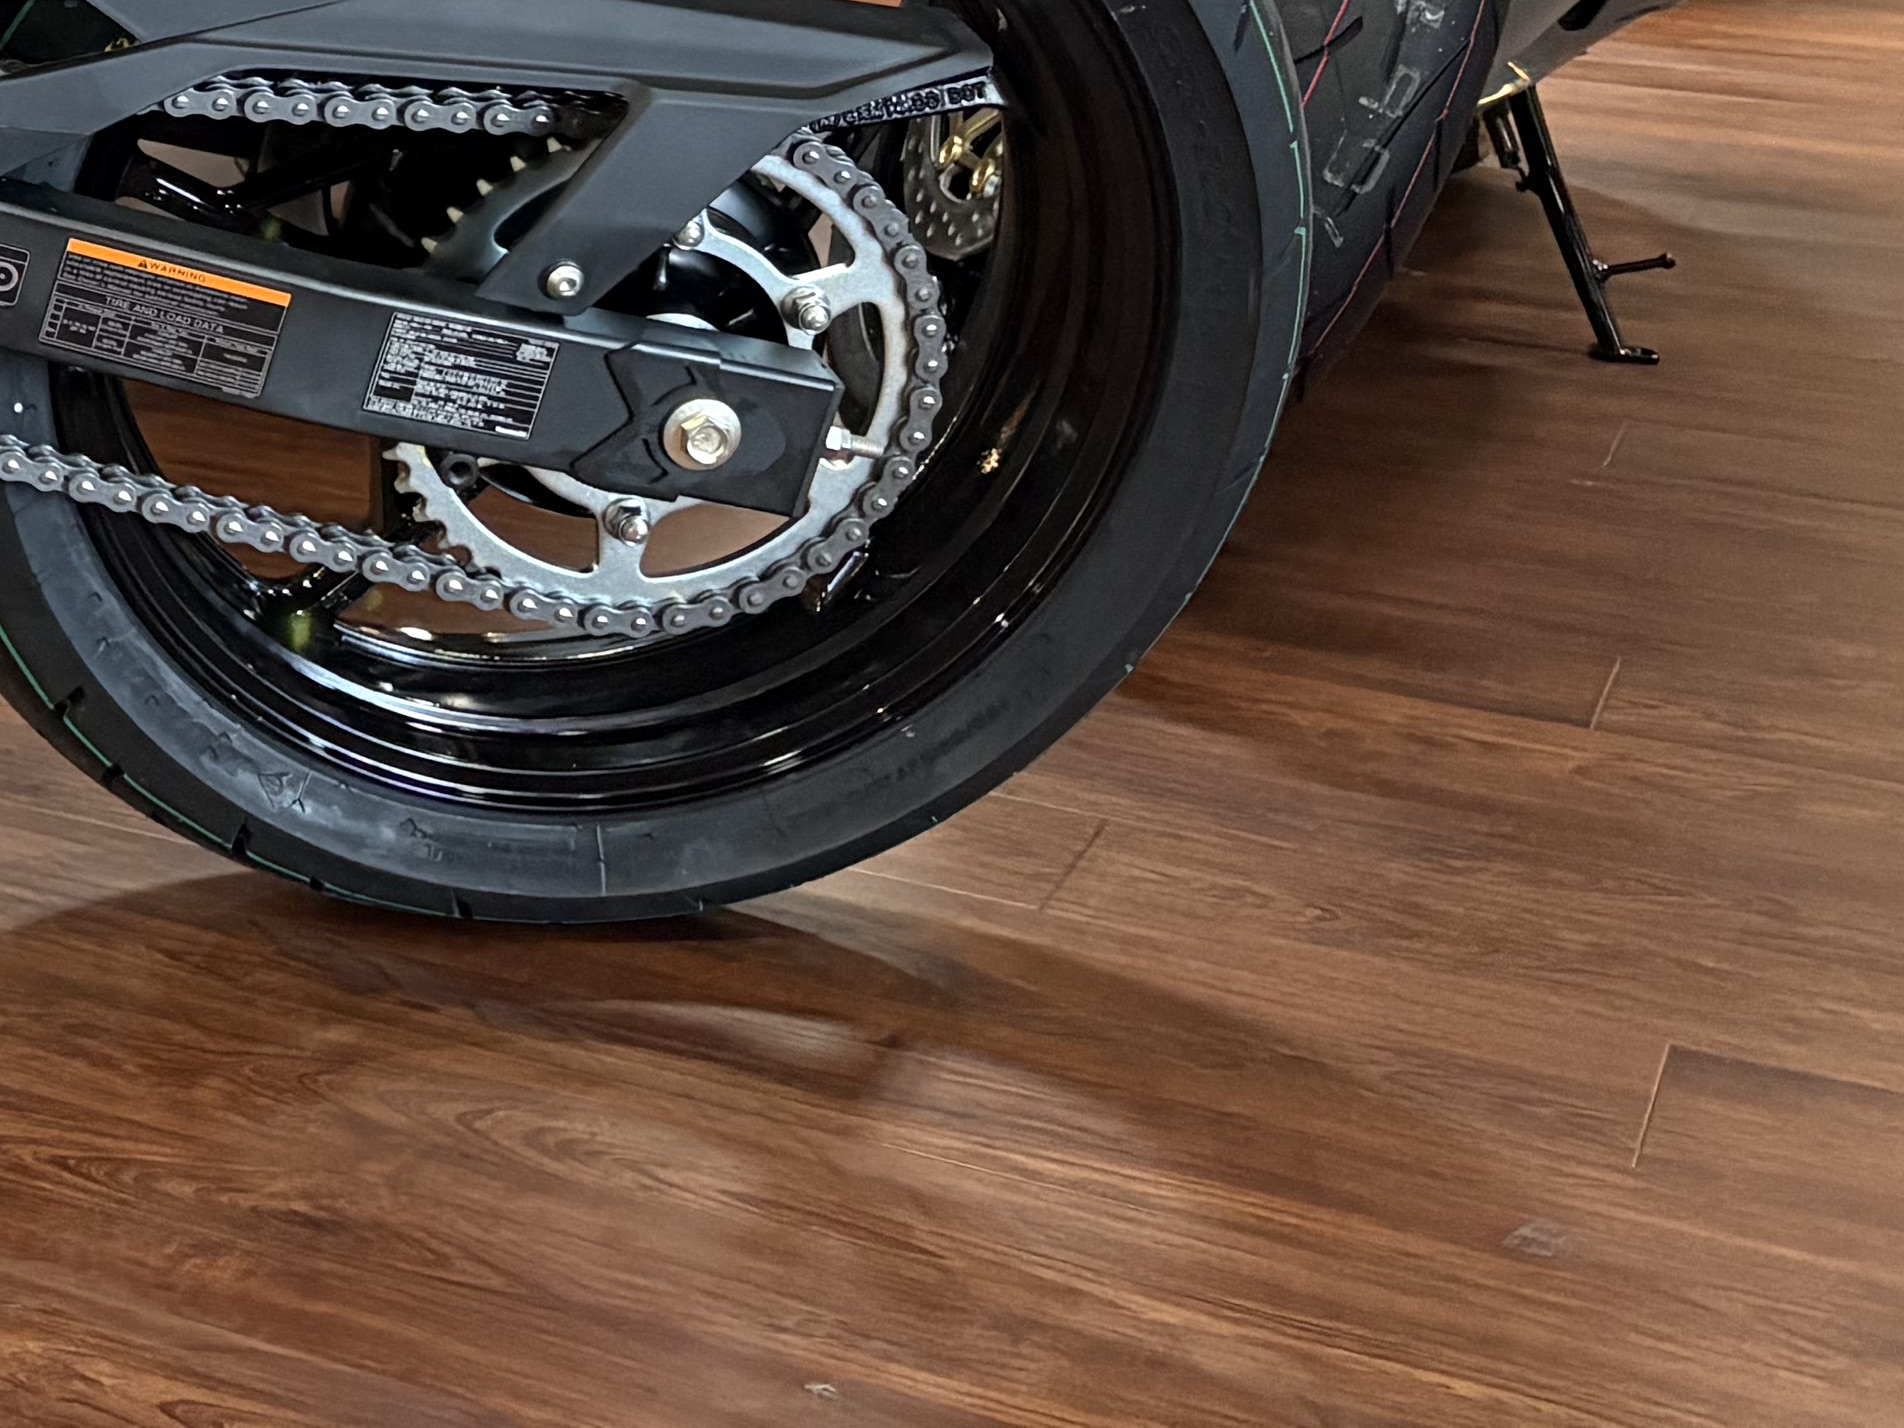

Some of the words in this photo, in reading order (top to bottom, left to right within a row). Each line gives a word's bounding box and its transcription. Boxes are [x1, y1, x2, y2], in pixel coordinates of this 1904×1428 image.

[149, 261, 207, 284] WARNING
[105, 296, 132, 310] TIRE
[133, 303, 158, 316] AND
[159, 311, 191, 326] LOAD
[193, 319, 225, 334] DATA
